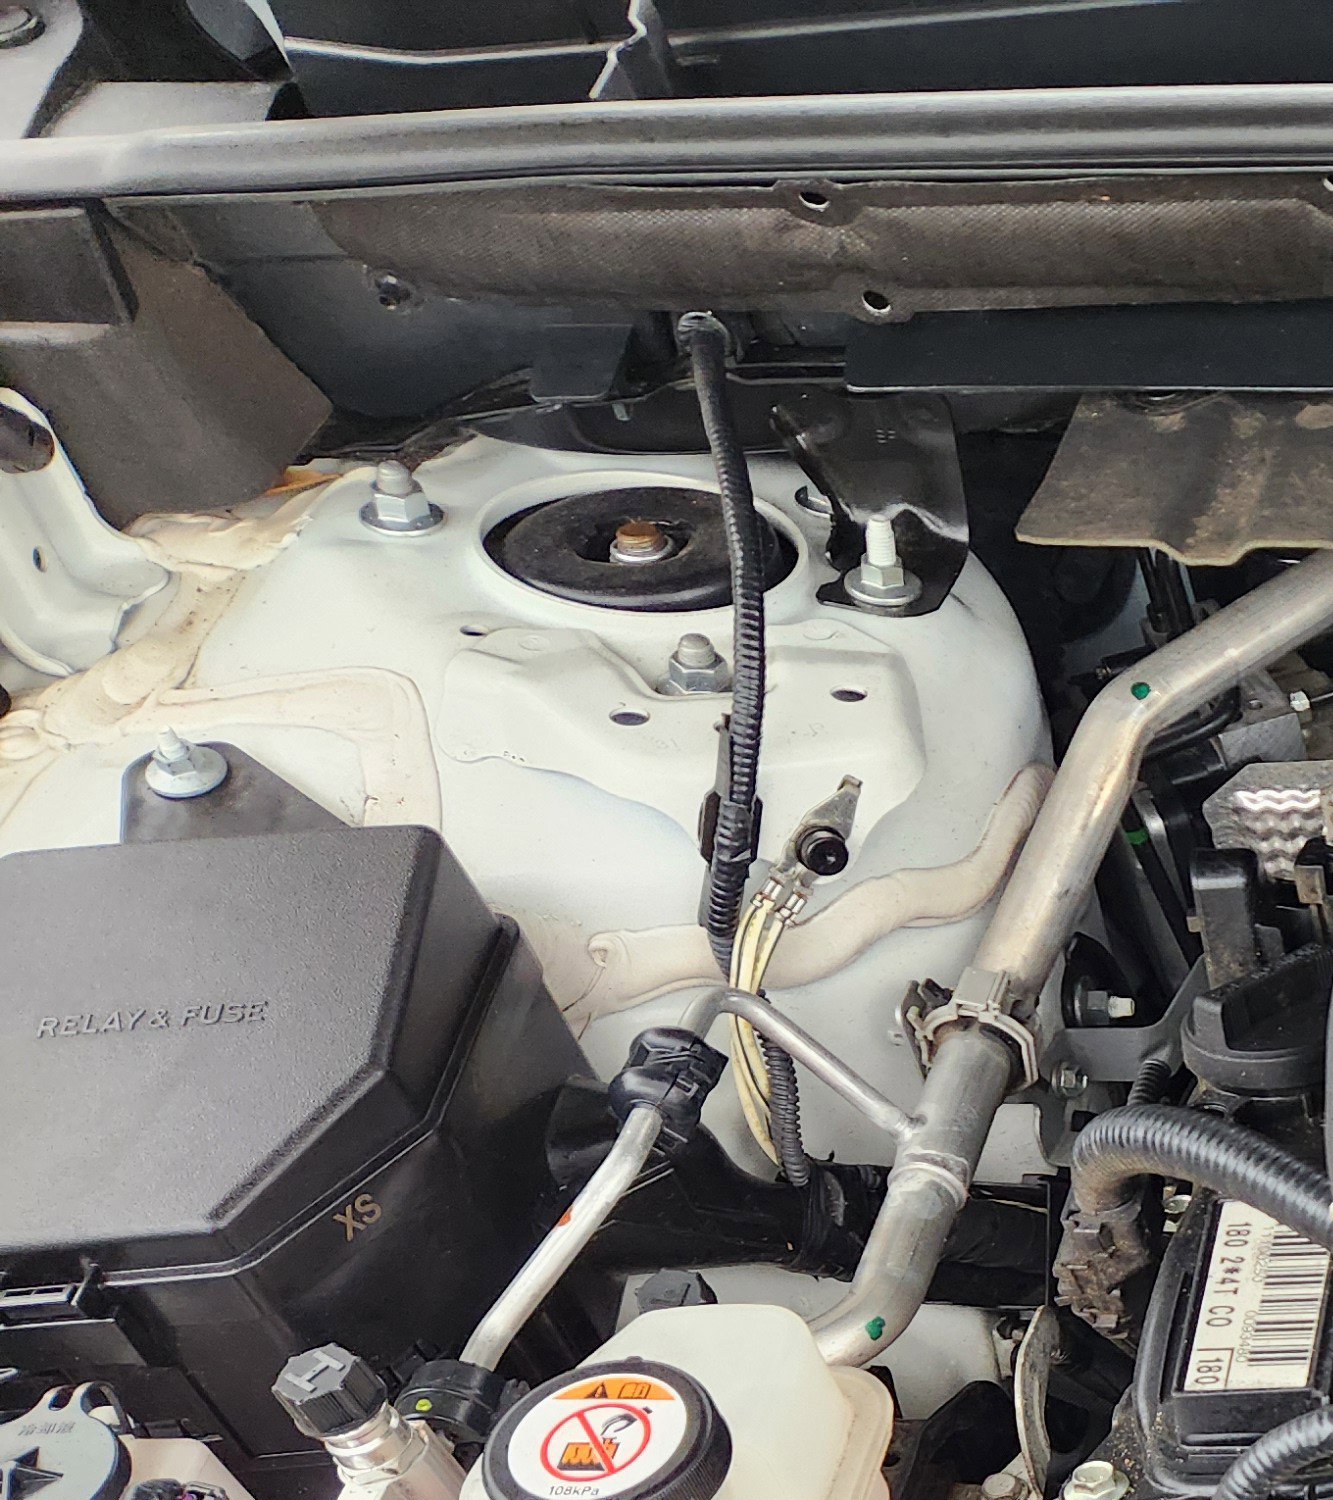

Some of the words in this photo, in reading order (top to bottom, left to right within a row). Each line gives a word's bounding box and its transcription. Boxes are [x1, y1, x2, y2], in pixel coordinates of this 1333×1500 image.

[36, 1007, 147, 1039] RELAY
[149, 1008, 172, 1029] &
[180, 1000, 270, 1028] FUSE
[332, 1193, 383, 1242] XS
[1223, 1222, 1253, 1248] 180
[284, 1350, 347, 1394] H
[1194, 1356, 1223, 1385] 180
[548, 1484, 601, 1497] 108kPa
